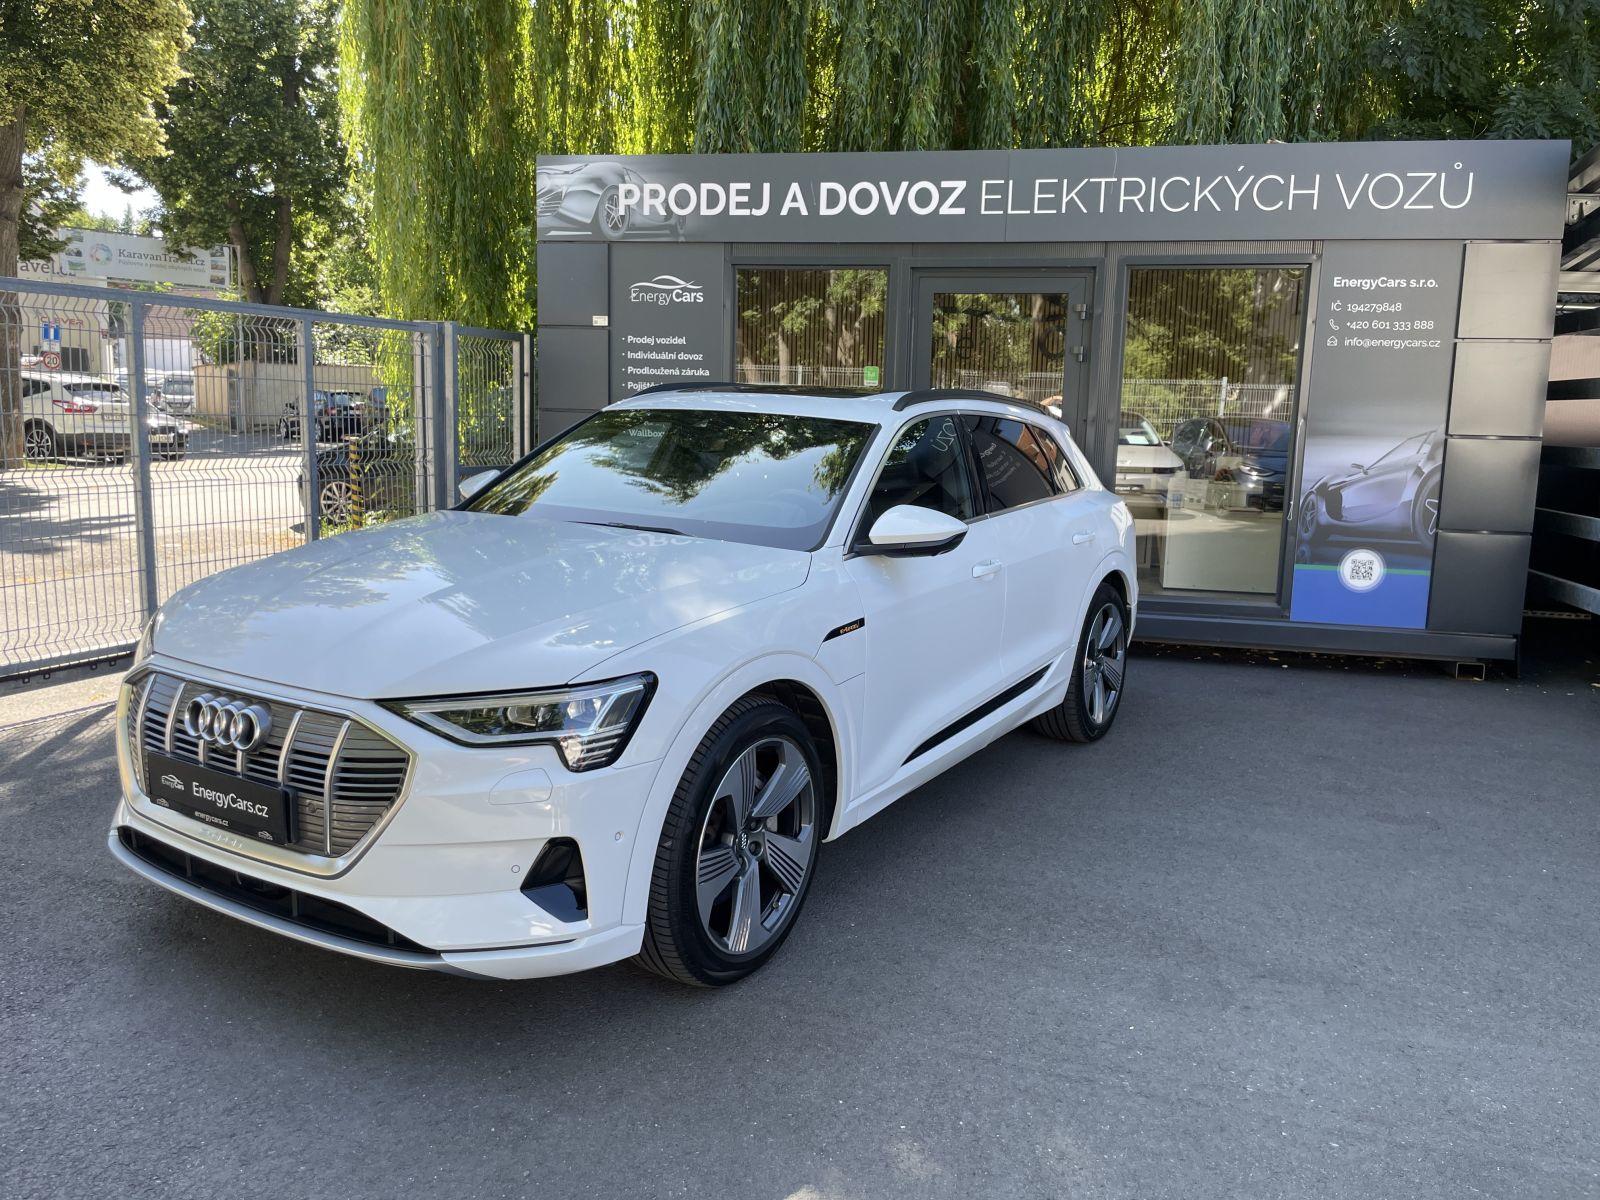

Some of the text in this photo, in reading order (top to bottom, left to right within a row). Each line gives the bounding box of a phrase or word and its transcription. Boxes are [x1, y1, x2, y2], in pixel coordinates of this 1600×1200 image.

[618, 162, 1475, 217] PRODEJ A DOVOZ ELEKTRICKÝCH VOZŮ
[1333, 276, 1439, 290] EnergyCars s.r.o.
[631, 288, 704, 305] EnergyCars
[1330, 300, 1342, 311] IČ
[1346, 320, 1434, 331] +420 601 333 888
[627, 335, 687, 346] Prodej vozidel
[1344, 337, 1441, 349] info@energycars.cz
[627, 351, 704, 361] Individuální dovoz
[627, 366, 710, 376] Prodloužená záruka
[192, 781, 269, 818] EnergyCars.cz
[194, 811, 229, 827] energycars.cz
